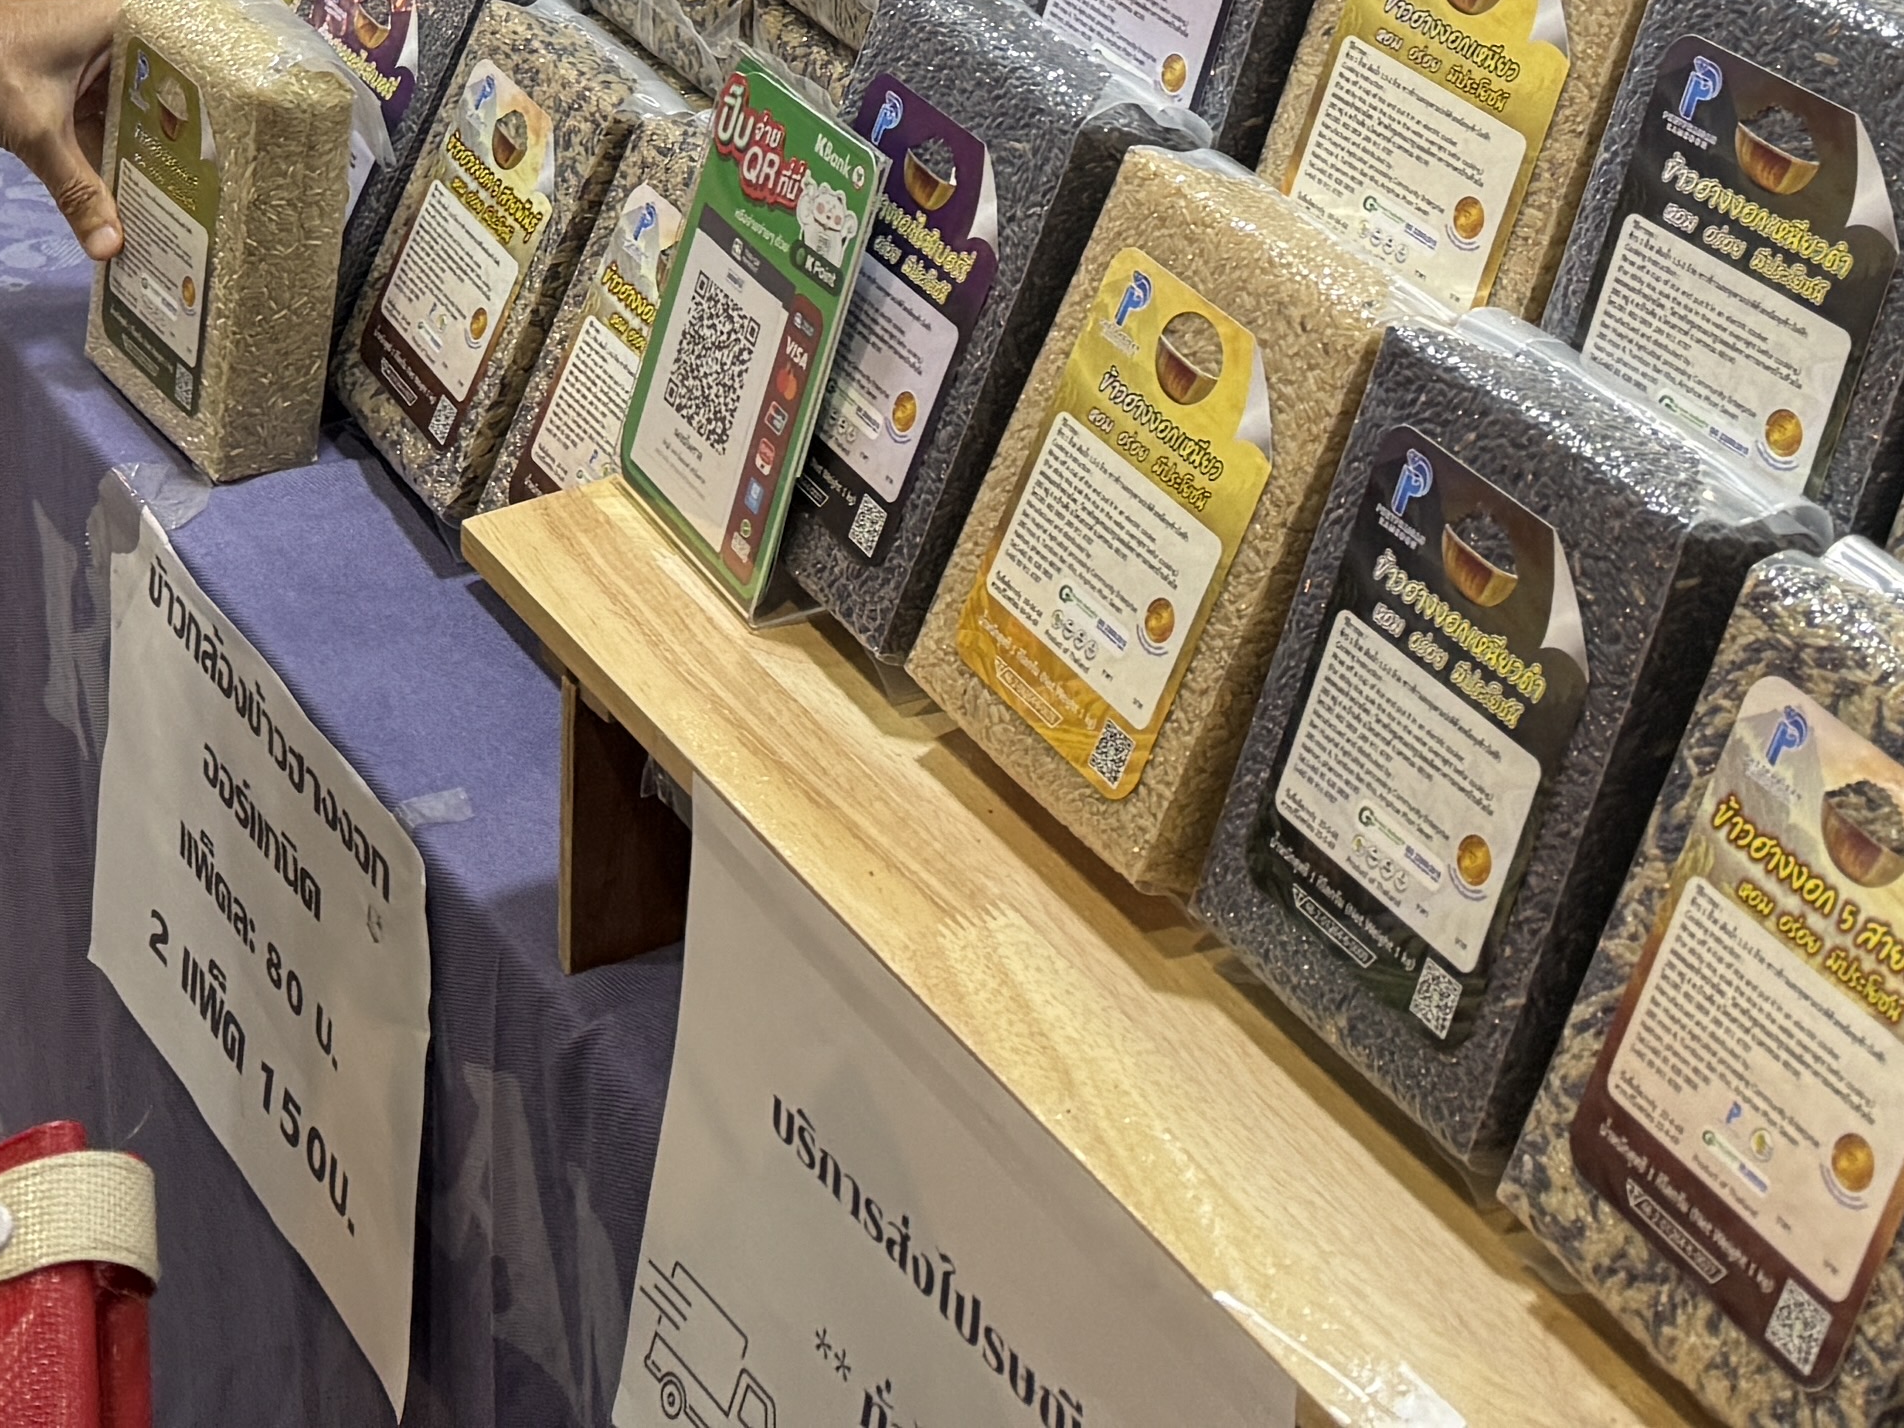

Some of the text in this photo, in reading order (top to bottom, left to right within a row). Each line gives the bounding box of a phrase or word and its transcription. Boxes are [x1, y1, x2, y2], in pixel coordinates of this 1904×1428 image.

[743, 146, 804, 200] QR ที่นี่
[815, 133, 852, 177] KBank
[786, 336, 808, 371] VISA
[147, 554, 392, 904] ข้าวกล้องข้าวฮางงอก
[1709, 798, 1840, 913] ข้าวฮางงอก
[1835, 899, 1858, 935] 5
[148, 908, 170, 964] 2
[1735, 878, 1775, 917] หอม
[1776, 912, 1823, 955] อร่อย
[264, 944, 306, 1021] 80
